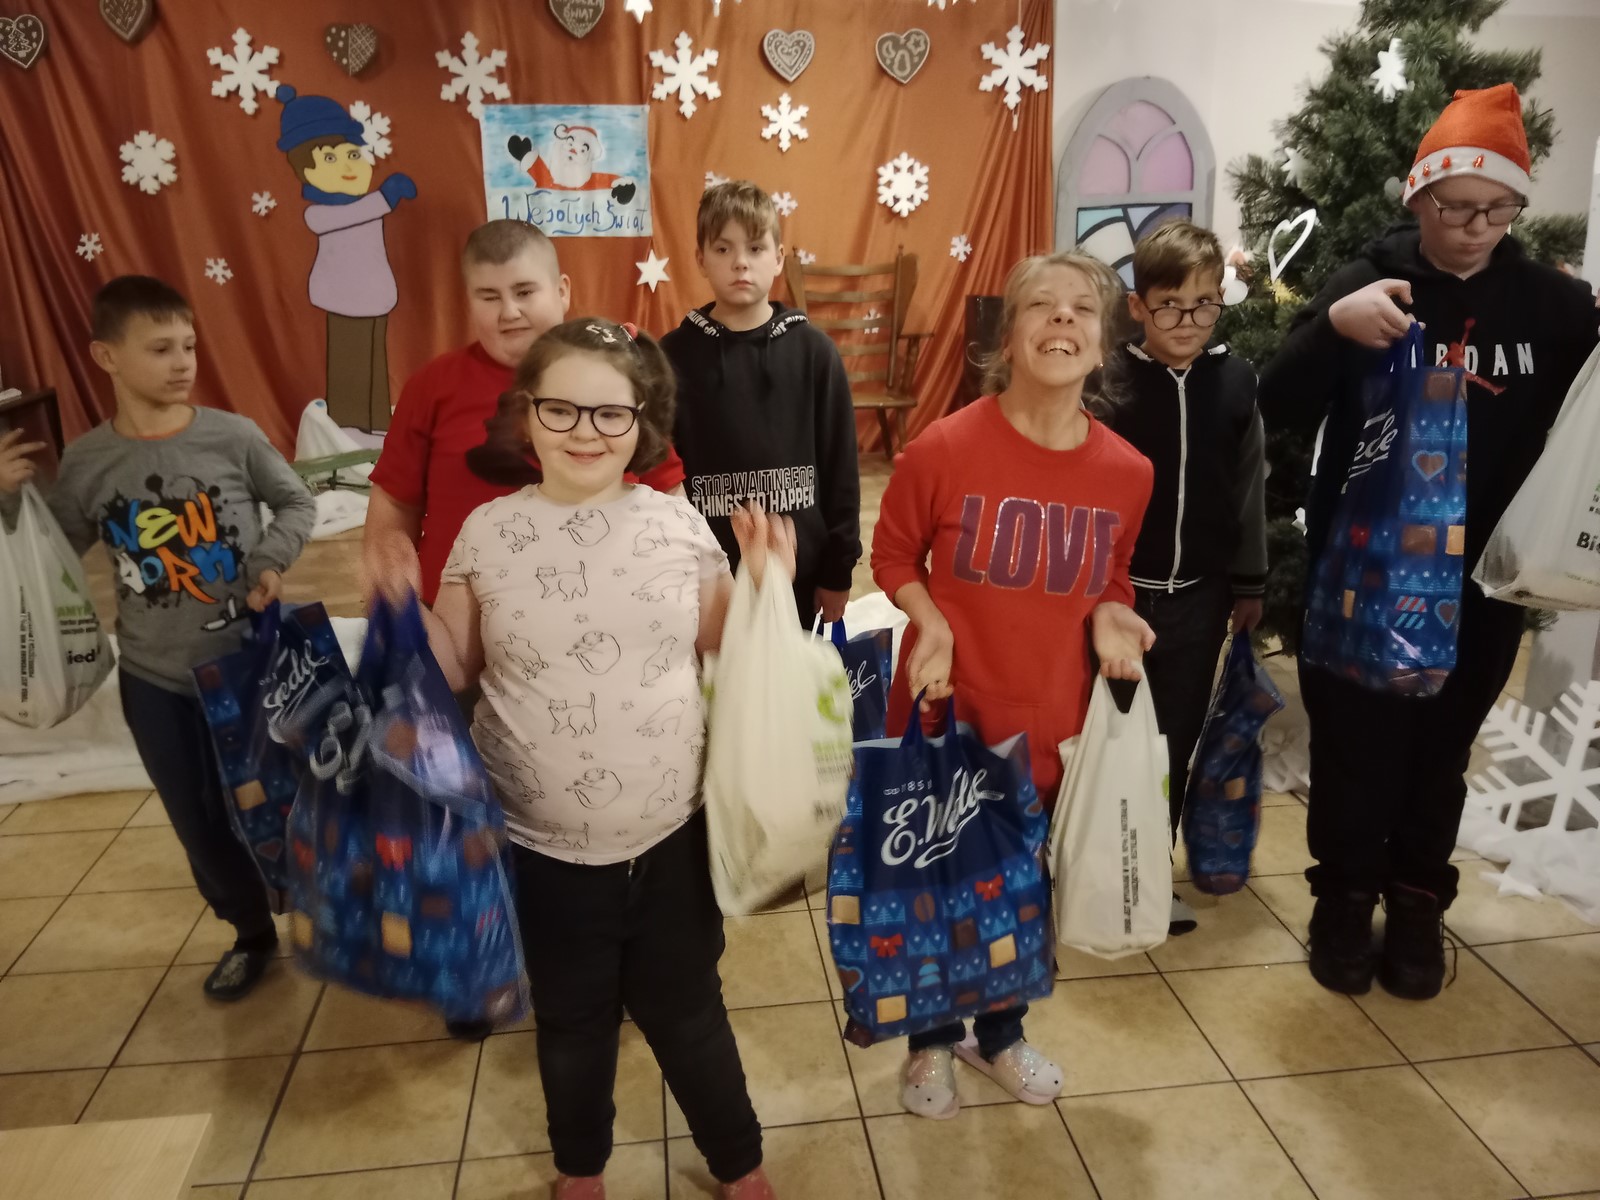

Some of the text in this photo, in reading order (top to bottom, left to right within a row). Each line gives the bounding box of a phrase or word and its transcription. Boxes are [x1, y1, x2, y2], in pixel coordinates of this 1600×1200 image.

[692, 465, 815, 498] STOP WAITING FOR
[769, 485, 815, 514] HAPPEN
[107, 492, 217, 552] NEW
